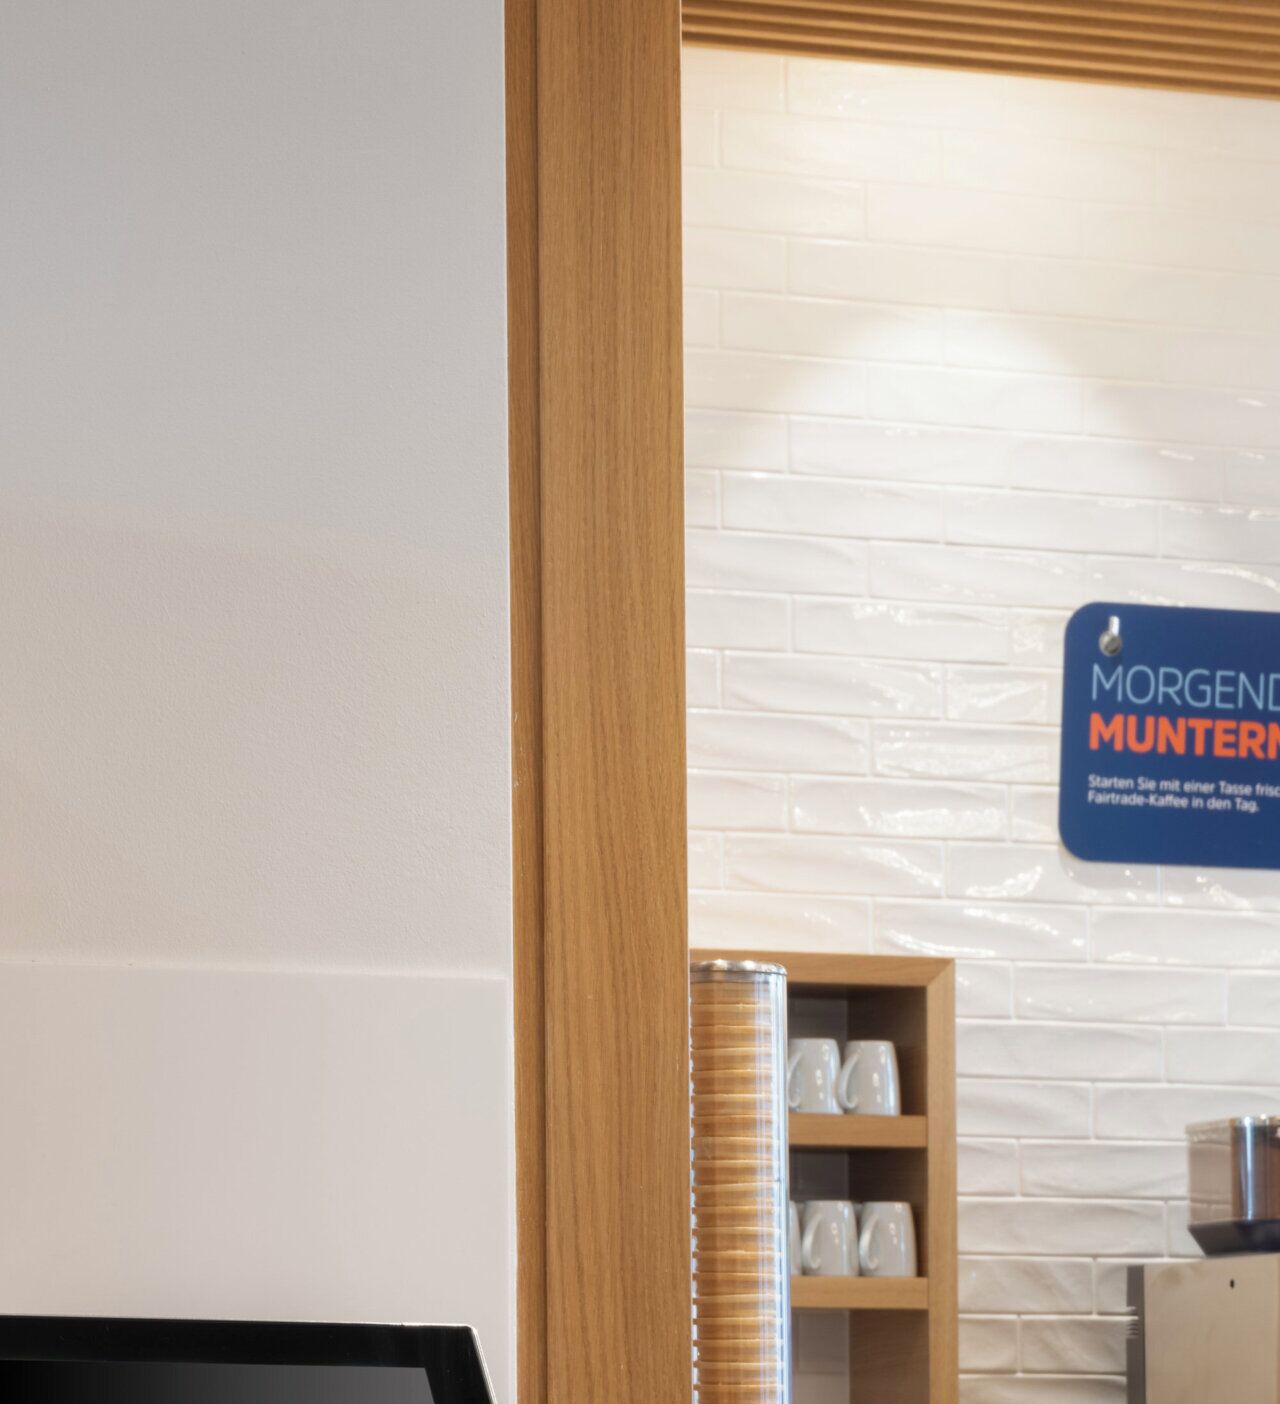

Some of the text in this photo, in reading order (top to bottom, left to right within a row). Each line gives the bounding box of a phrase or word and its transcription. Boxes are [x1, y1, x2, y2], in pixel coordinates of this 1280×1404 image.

[1088, 774, 1135, 789] Starten
[1137, 777, 1156, 791] Sie
[1159, 778, 1180, 792] mit
[1183, 779, 1215, 793] einer
[1219, 781, 1252, 796] Tasse
[1088, 790, 1260, 813] Fairtrade-Kaffee in den Tag.
